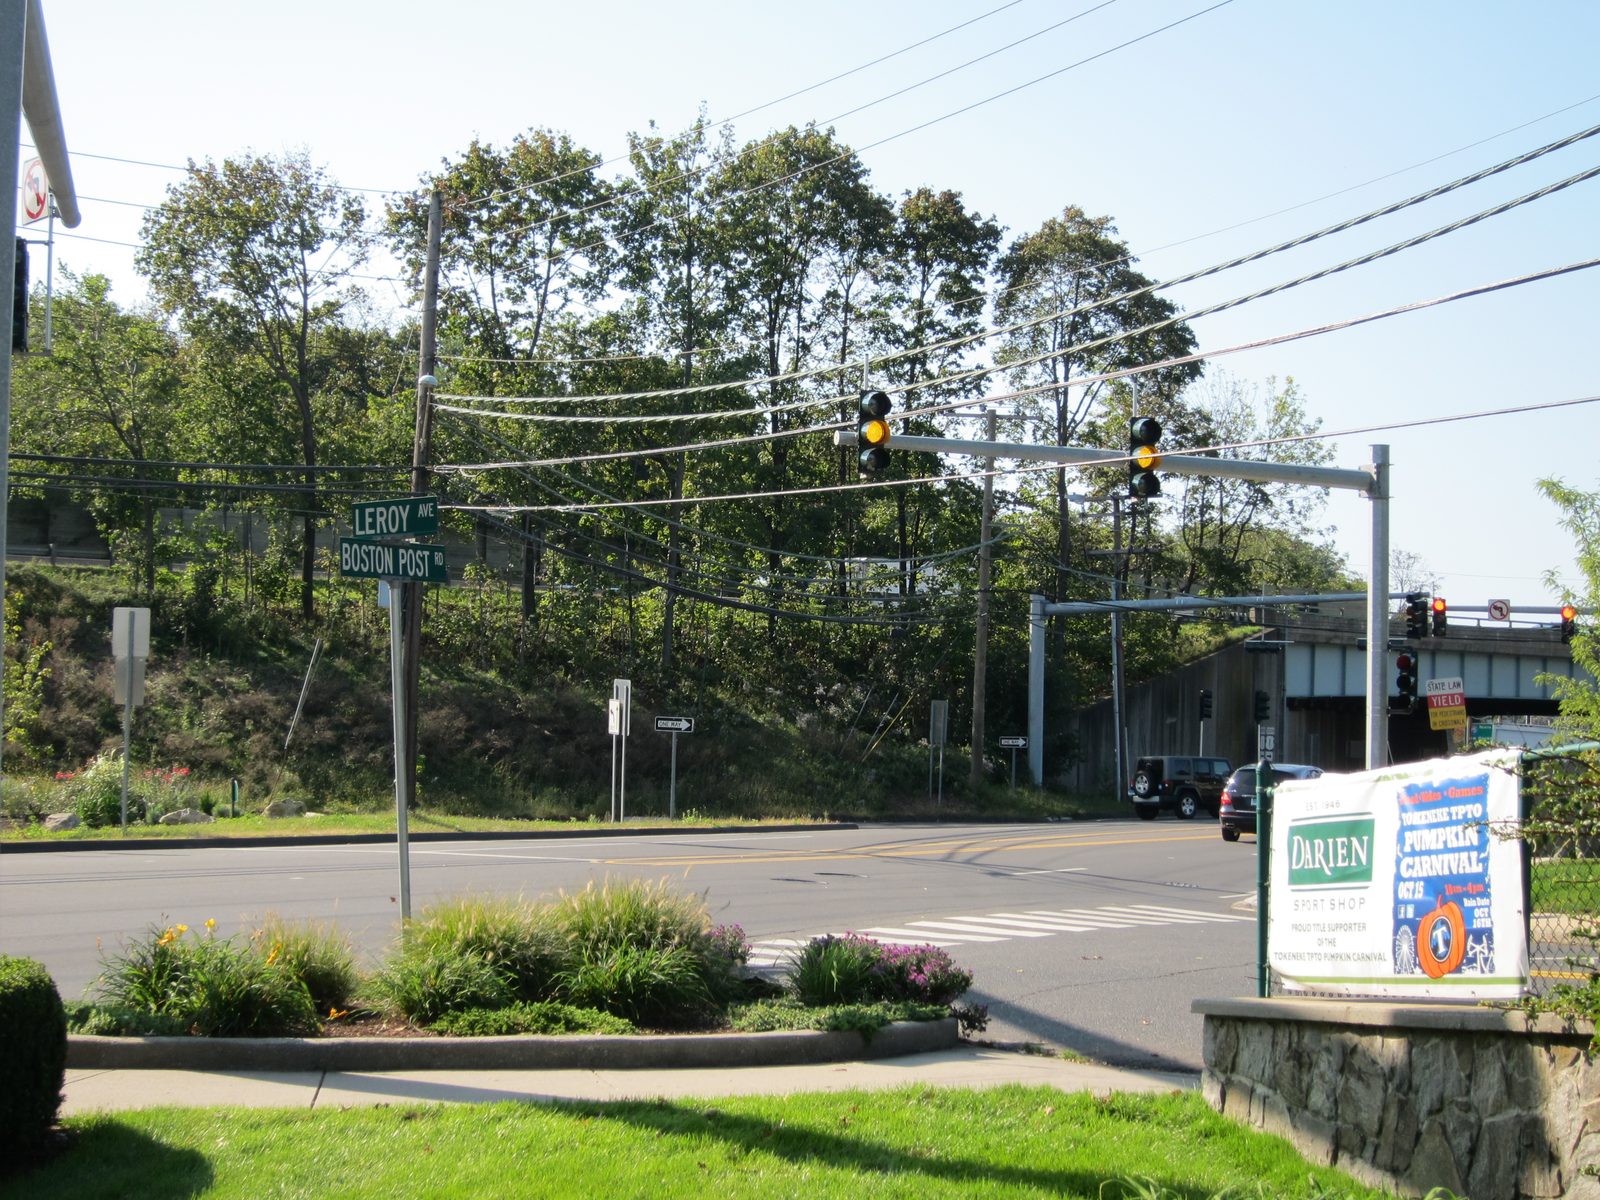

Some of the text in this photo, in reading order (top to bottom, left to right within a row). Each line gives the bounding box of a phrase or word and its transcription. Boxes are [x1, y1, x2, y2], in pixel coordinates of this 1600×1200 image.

[355, 502, 435, 536] LEROY AVE
[342, 542, 444, 578] BOSTON POST RD
[1427, 680, 1462, 692] STATE LAW
[1431, 694, 1461, 707] YIELD
[1401, 803, 1483, 826] TOKENEKE TPTO
[1403, 825, 1479, 852] PUMPKIN
[1291, 835, 1369, 876] DARIEN
[1400, 851, 1483, 878] CARNIVAL
[1398, 880, 1424, 899] OCT 15
[1293, 897, 1366, 911] SPORT SHOP
[1474, 907, 1489, 918] OCT
[1291, 922, 1367, 933] PROUD TITLE SUPPORTER
[1324, 937, 1336, 947] THE
[1274, 952, 1387, 962] TOKENEKE TPTO PUMPKIN CARNIVAL
